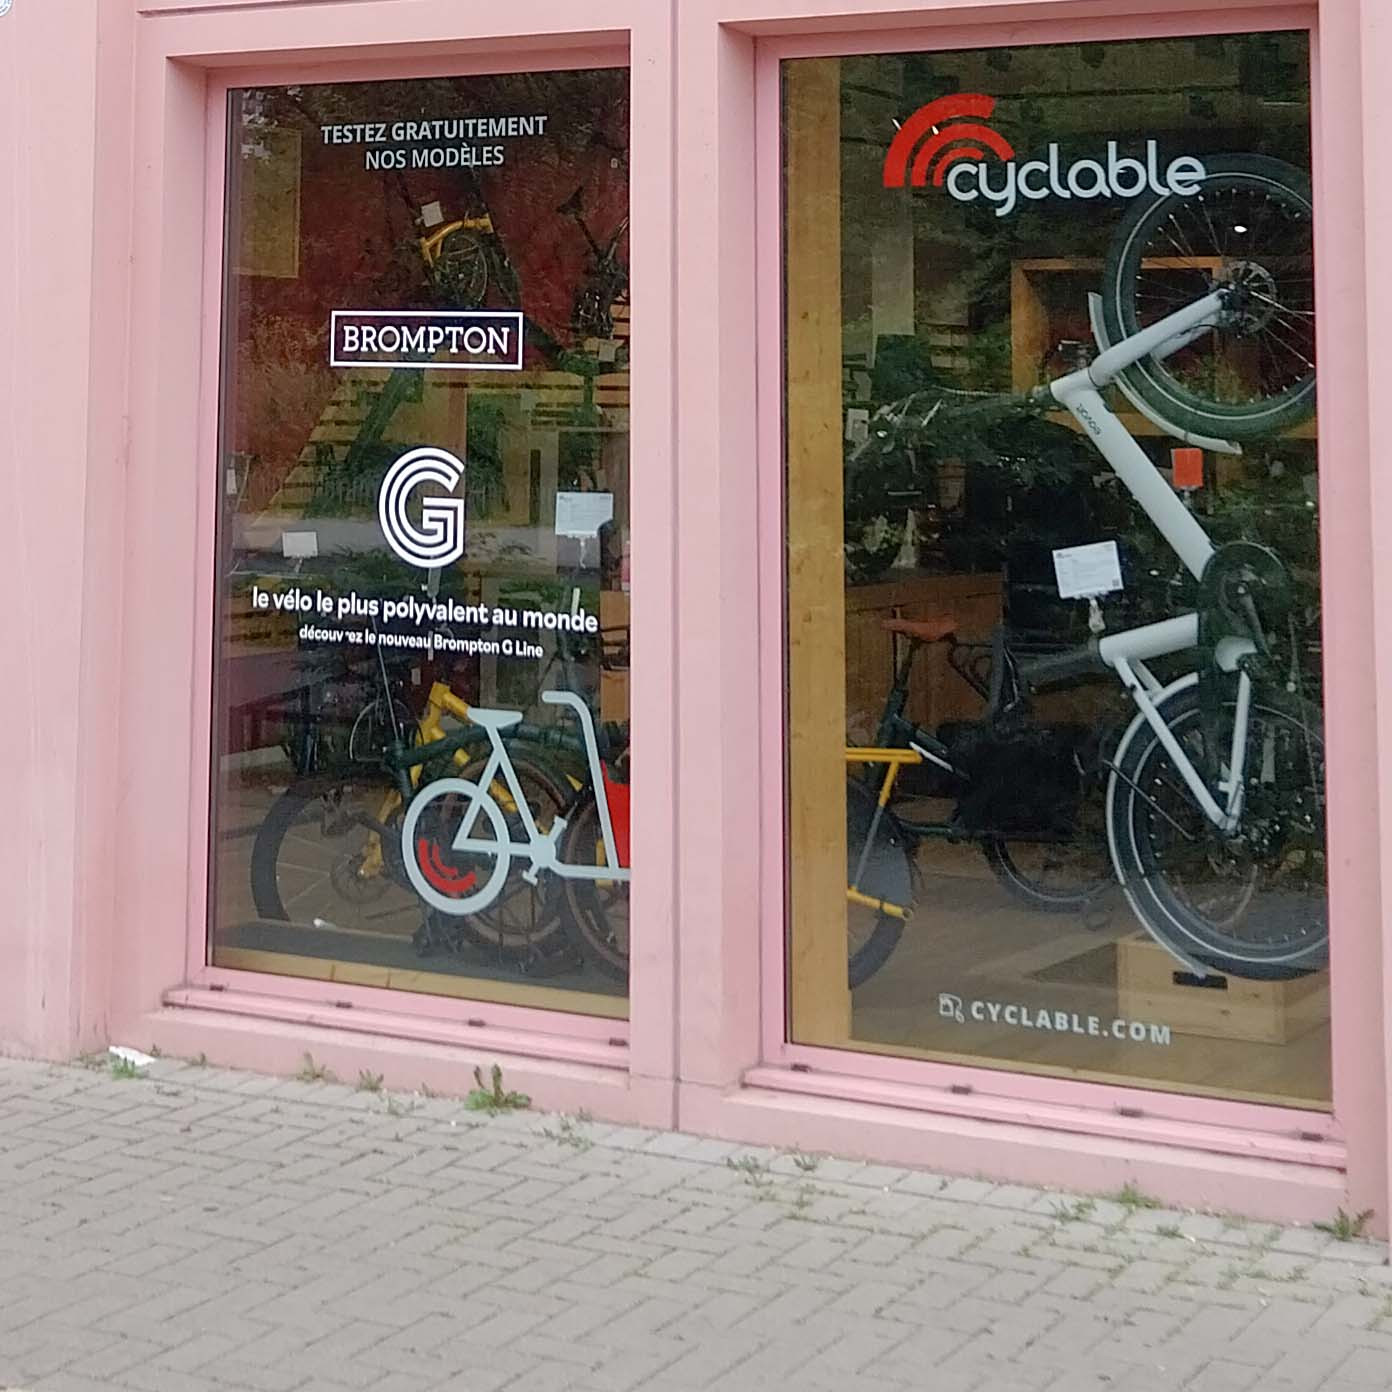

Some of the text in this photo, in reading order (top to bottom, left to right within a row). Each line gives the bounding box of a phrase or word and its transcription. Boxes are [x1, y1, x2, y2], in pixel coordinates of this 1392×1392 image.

[321, 116, 548, 144] TESTEZ GRATUITEMENT
[365, 142, 505, 170] NOS MODÈLES
[947, 140, 1206, 216] cyclable
[343, 325, 510, 354] BROMPTON
[378, 447, 465, 568] G
[252, 586, 598, 633] le vélo le plus polyvalent au monde
[365, 628, 377, 645] le
[378, 633, 431, 648] nouveau
[434, 634, 500, 656] Brompton
[502, 639, 513, 655] G
[515, 640, 544, 658] Line
[971, 1001, 1171, 1045] CYCLABLE.COM
